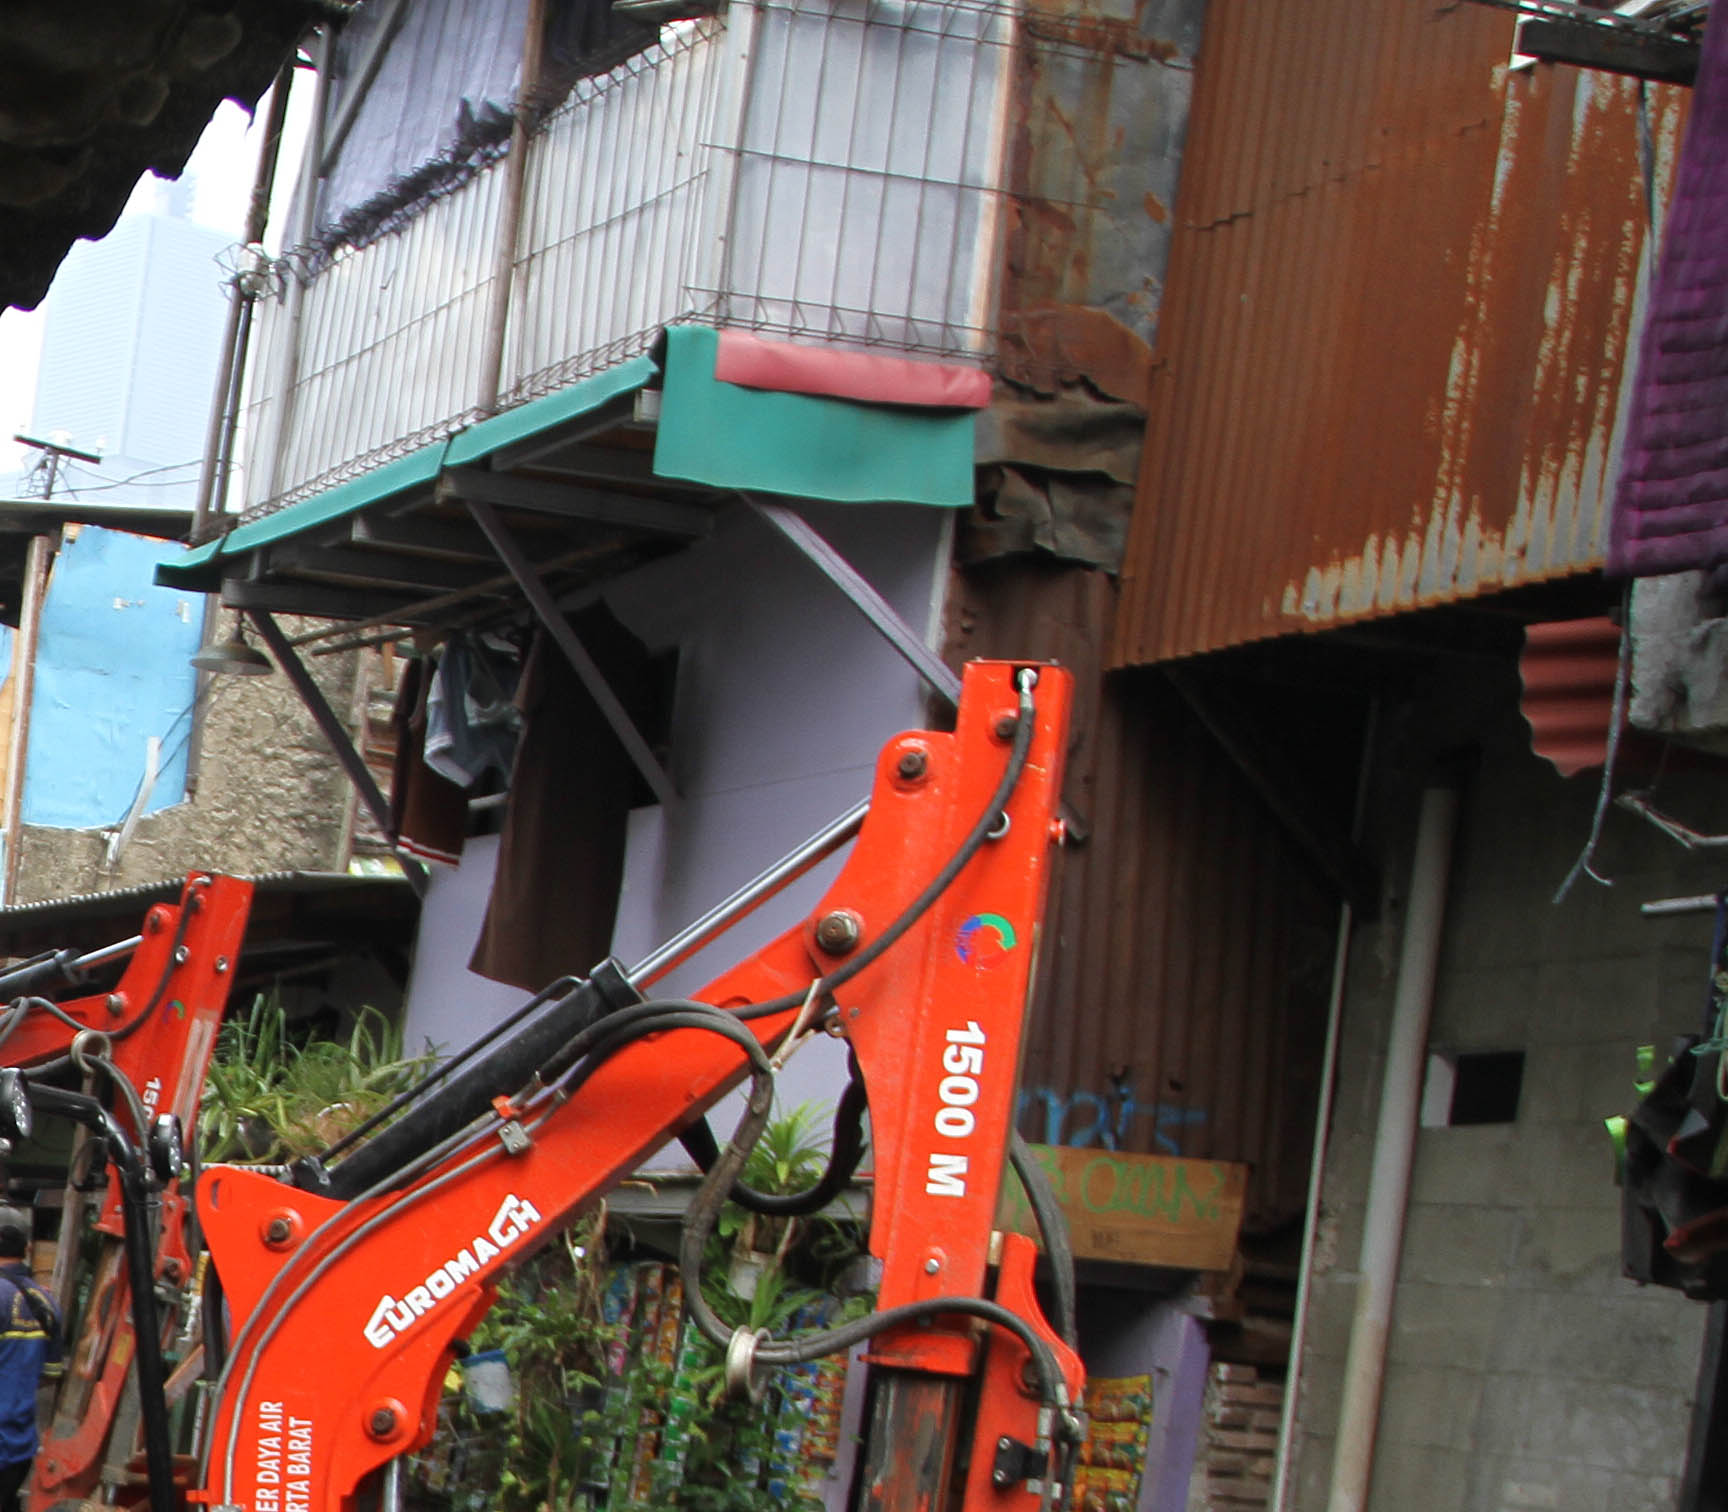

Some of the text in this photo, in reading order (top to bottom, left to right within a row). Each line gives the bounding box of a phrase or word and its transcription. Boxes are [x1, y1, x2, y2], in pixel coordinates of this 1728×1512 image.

[925, 1020, 987, 1197] 1500 M
[363, 1193, 542, 1349] EUROMACH
[259, 1401, 284, 1433] AIR
[286, 1415, 313, 1475] BARAT
[256, 1436, 282, 1484] DAYA
